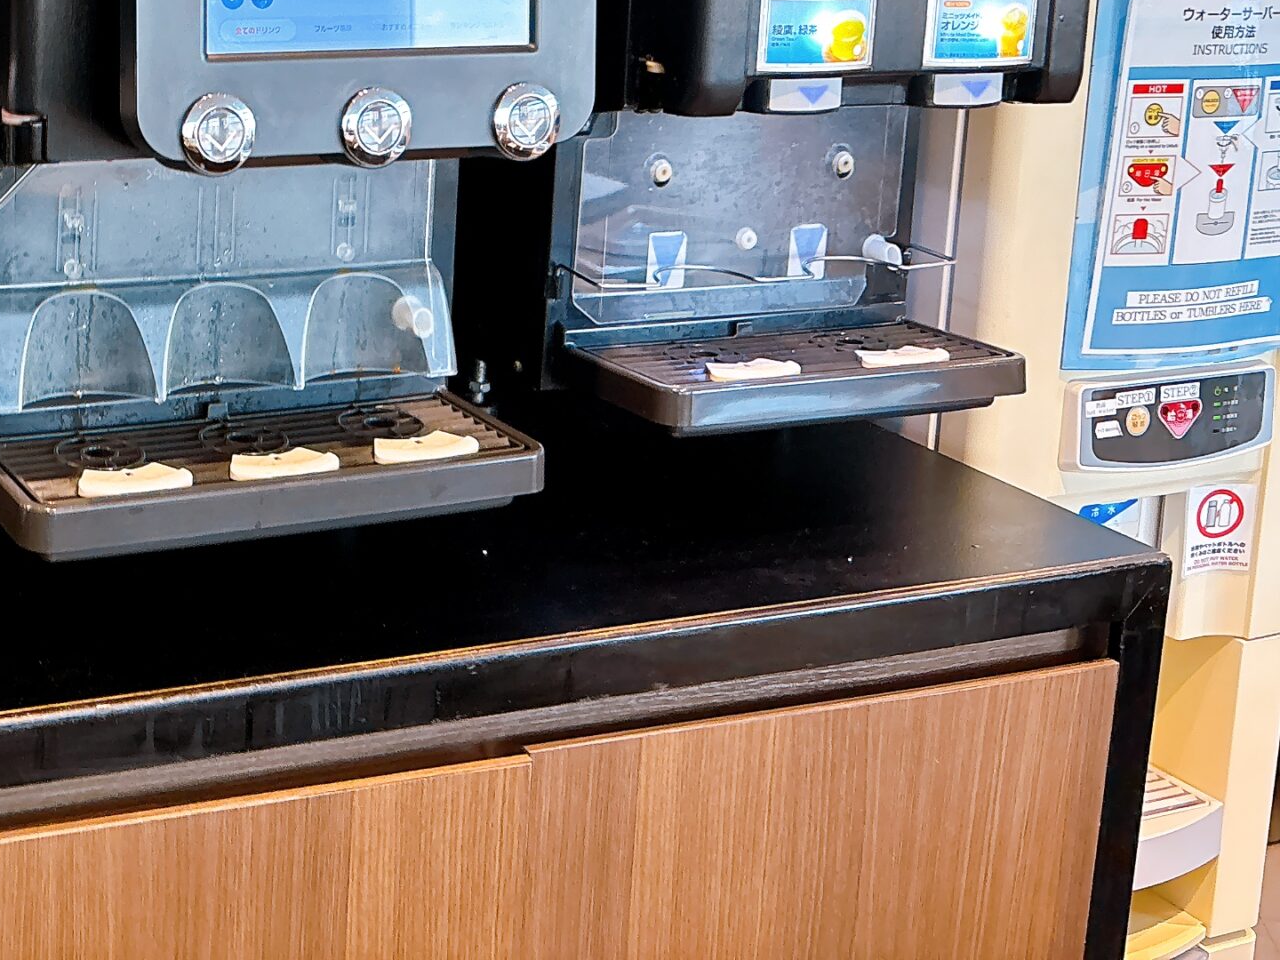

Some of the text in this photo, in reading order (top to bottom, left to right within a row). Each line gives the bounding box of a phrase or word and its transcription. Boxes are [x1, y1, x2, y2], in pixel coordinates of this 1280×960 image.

[1183, 5, 1280, 21] ウォーターサーバー
[940, 21, 979, 30] オレンジ
[1211, 25, 1257, 39] 使用方法
[1192, 43, 1269, 56] INSTRUCTIONS
[1148, 85, 1168, 93] HOT
[1138, 283, 1256, 305] PLEASE DO NOT REFILL
[1115, 300, 1263, 322] BOTTLES or TUMBLERS HERE
[1090, 504, 1117, 518] 冷水
